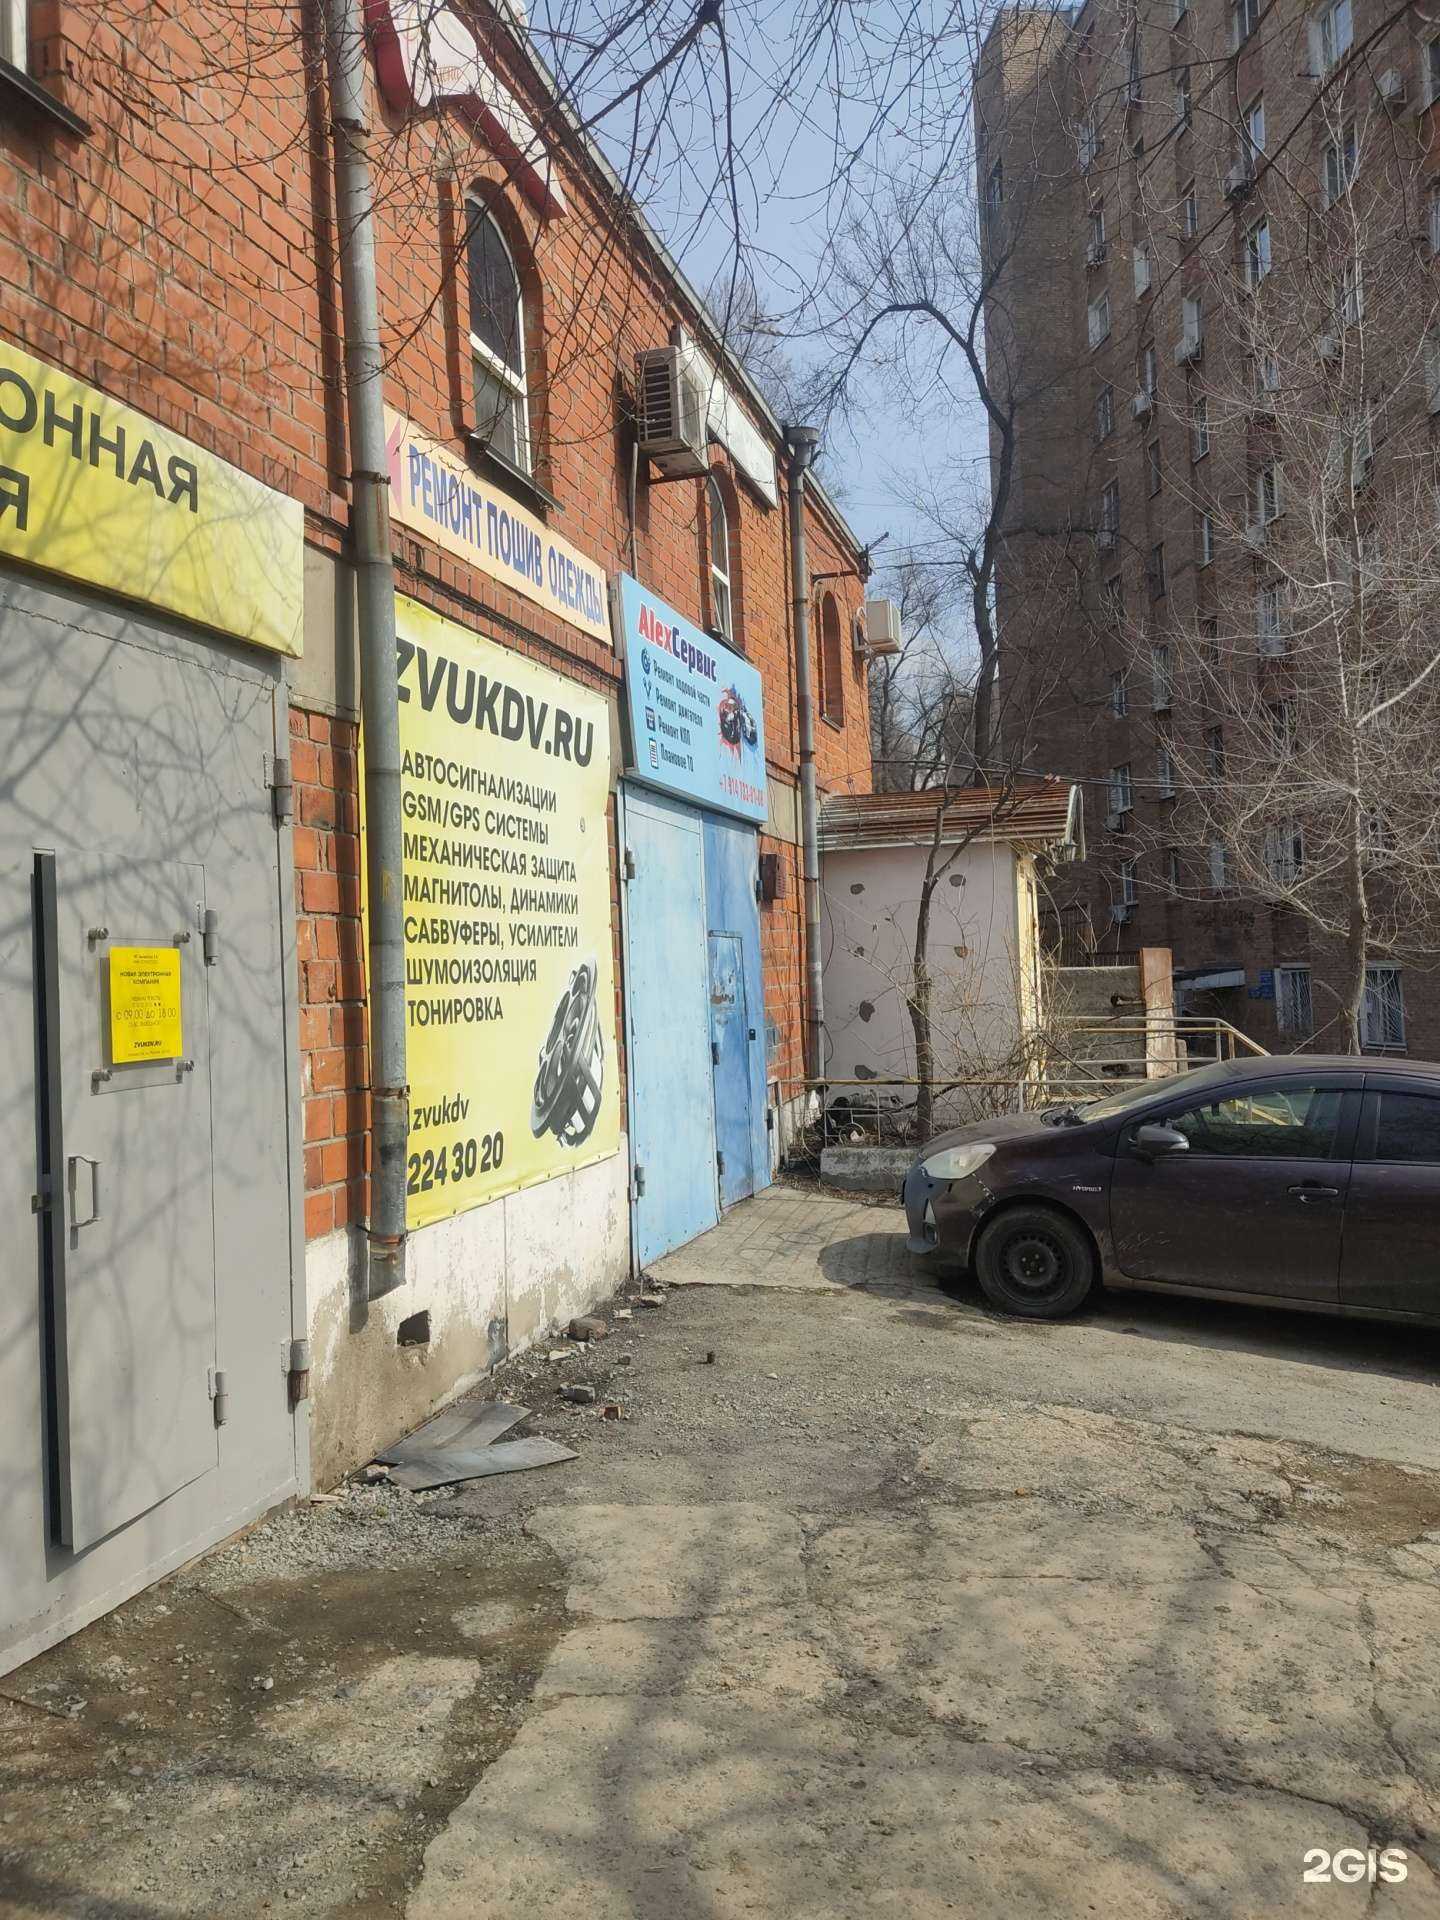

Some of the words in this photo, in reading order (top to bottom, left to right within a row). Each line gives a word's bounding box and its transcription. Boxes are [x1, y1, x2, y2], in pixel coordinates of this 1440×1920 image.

[409, 443, 482, 549] РЕМОНТ
[486, 500, 543, 588] ПОШИВ
[548, 545, 606, 627] ОДЕЖДЫ
[653, 659, 675, 686] Ремонт
[395, 636, 594, 768] ZVUKDV.RU
[655, 687, 677, 713] Ремонт
[658, 715, 679, 740] Ремонт
[401, 749, 557, 813] АВТОСИГНАЛИЗАЦИИ
[402, 790, 480, 832] GSM/GPS
[485, 810, 549, 845] СИСТЕМЫ
[403, 832, 527, 876] МЕХАНИЧЕСКАЯ
[531, 854, 577, 883] ЗАЩИТА
[403, 874, 506, 914] МАГНИТОЛЫ,
[510, 887, 578, 915] ДИНАМИКИ
[404, 916, 505, 950] САБВУФЕРЫ,
[509, 923, 578, 947] УСИЛИТЕЛИ
[406, 958, 537, 986] ШУМОИЗОЛЯЦИЯ
[407, 996, 504, 1027] ТОНИРОВКА
[412, 1092, 470, 1131] zvukdv
[406, 1148, 448, 1196] 224
[451, 1138, 477, 1183] 30
[480, 1131, 504, 1174] 20
